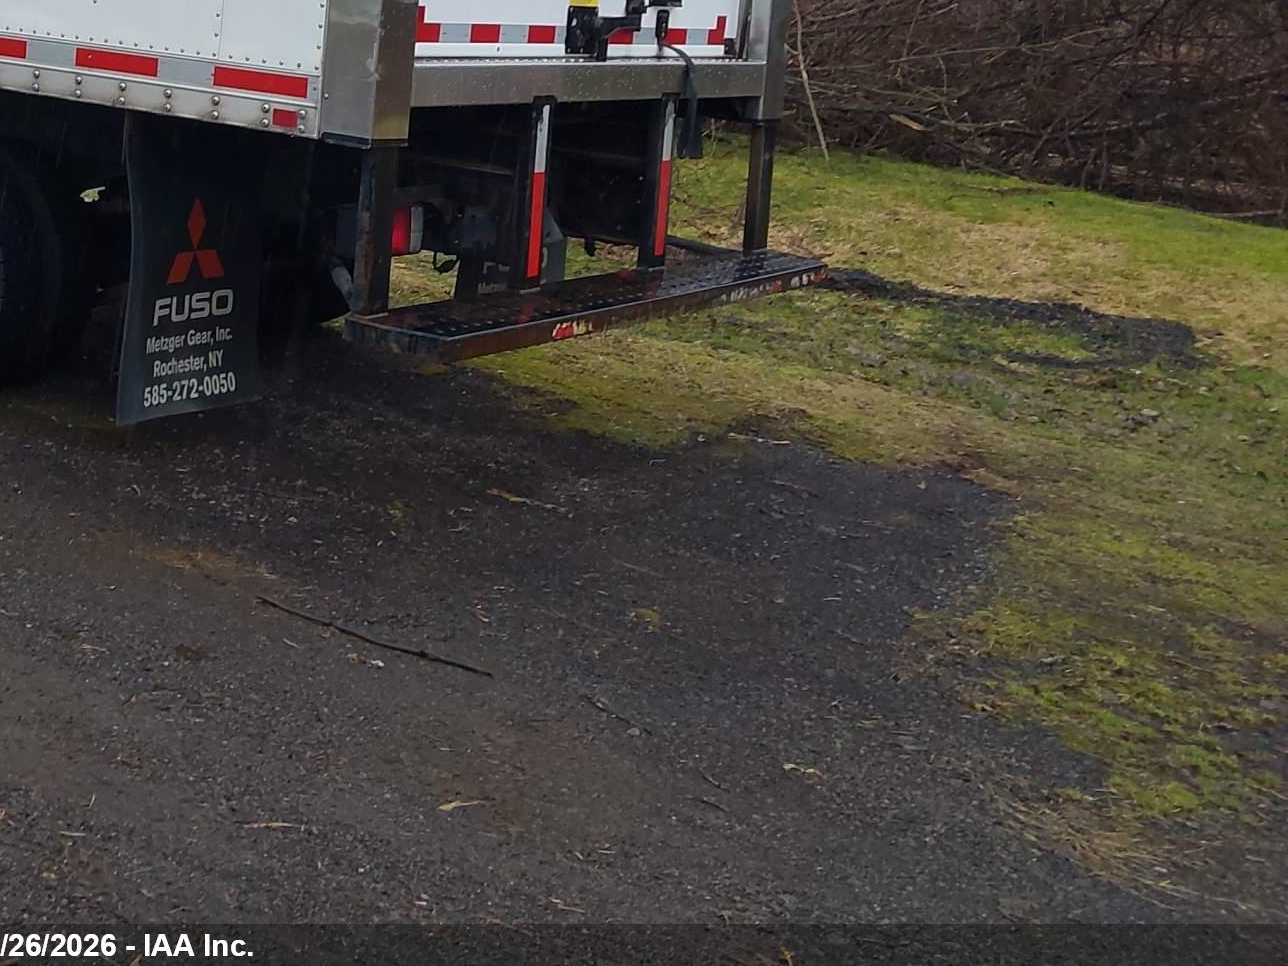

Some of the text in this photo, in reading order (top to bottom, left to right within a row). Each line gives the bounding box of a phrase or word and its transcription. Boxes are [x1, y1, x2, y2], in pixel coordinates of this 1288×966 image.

[153, 289, 234, 326] FUSO
[146, 326, 233, 354] Metzger Gear, Inc.
[153, 349, 224, 378] Rochester, NY
[144, 371, 236, 408] 585-272-0050
